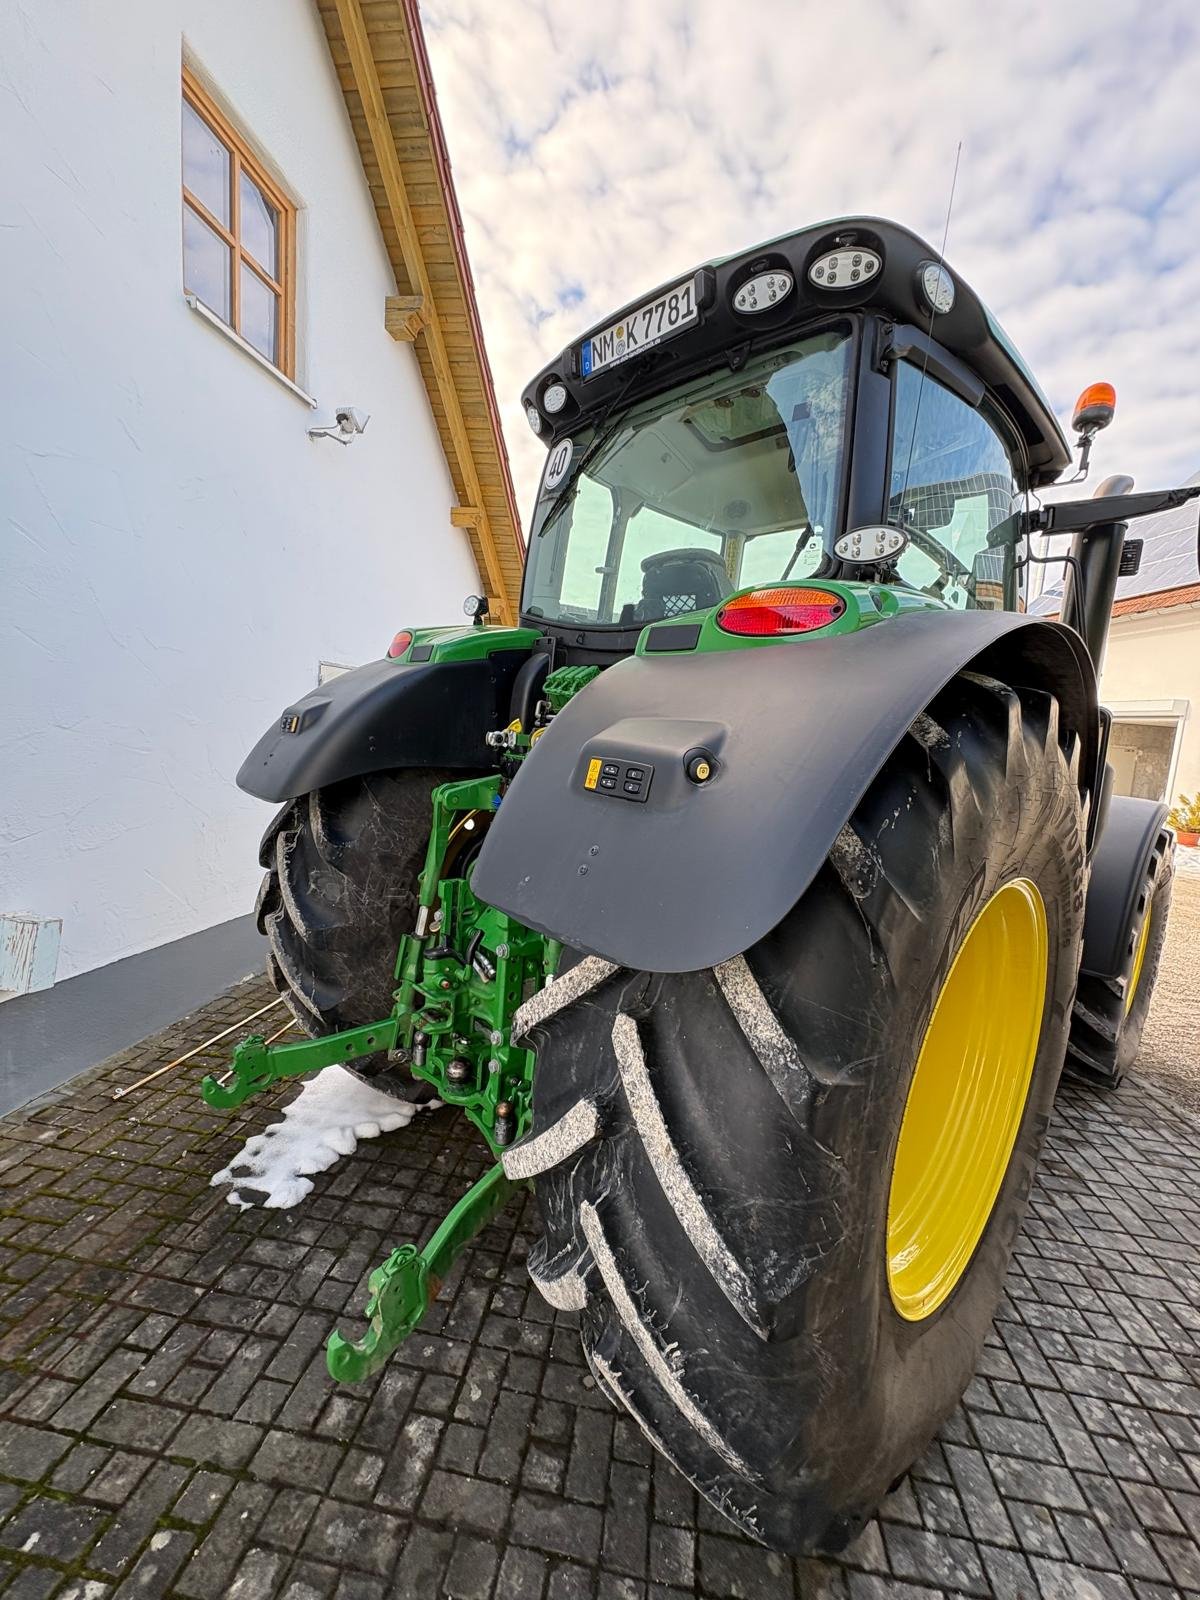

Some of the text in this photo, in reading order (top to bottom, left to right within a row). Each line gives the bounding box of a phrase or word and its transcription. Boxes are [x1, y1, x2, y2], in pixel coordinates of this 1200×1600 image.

[592, 286, 694, 368] NM K 7781
[585, 361, 590, 370] D
[549, 446, 568, 479] 40
